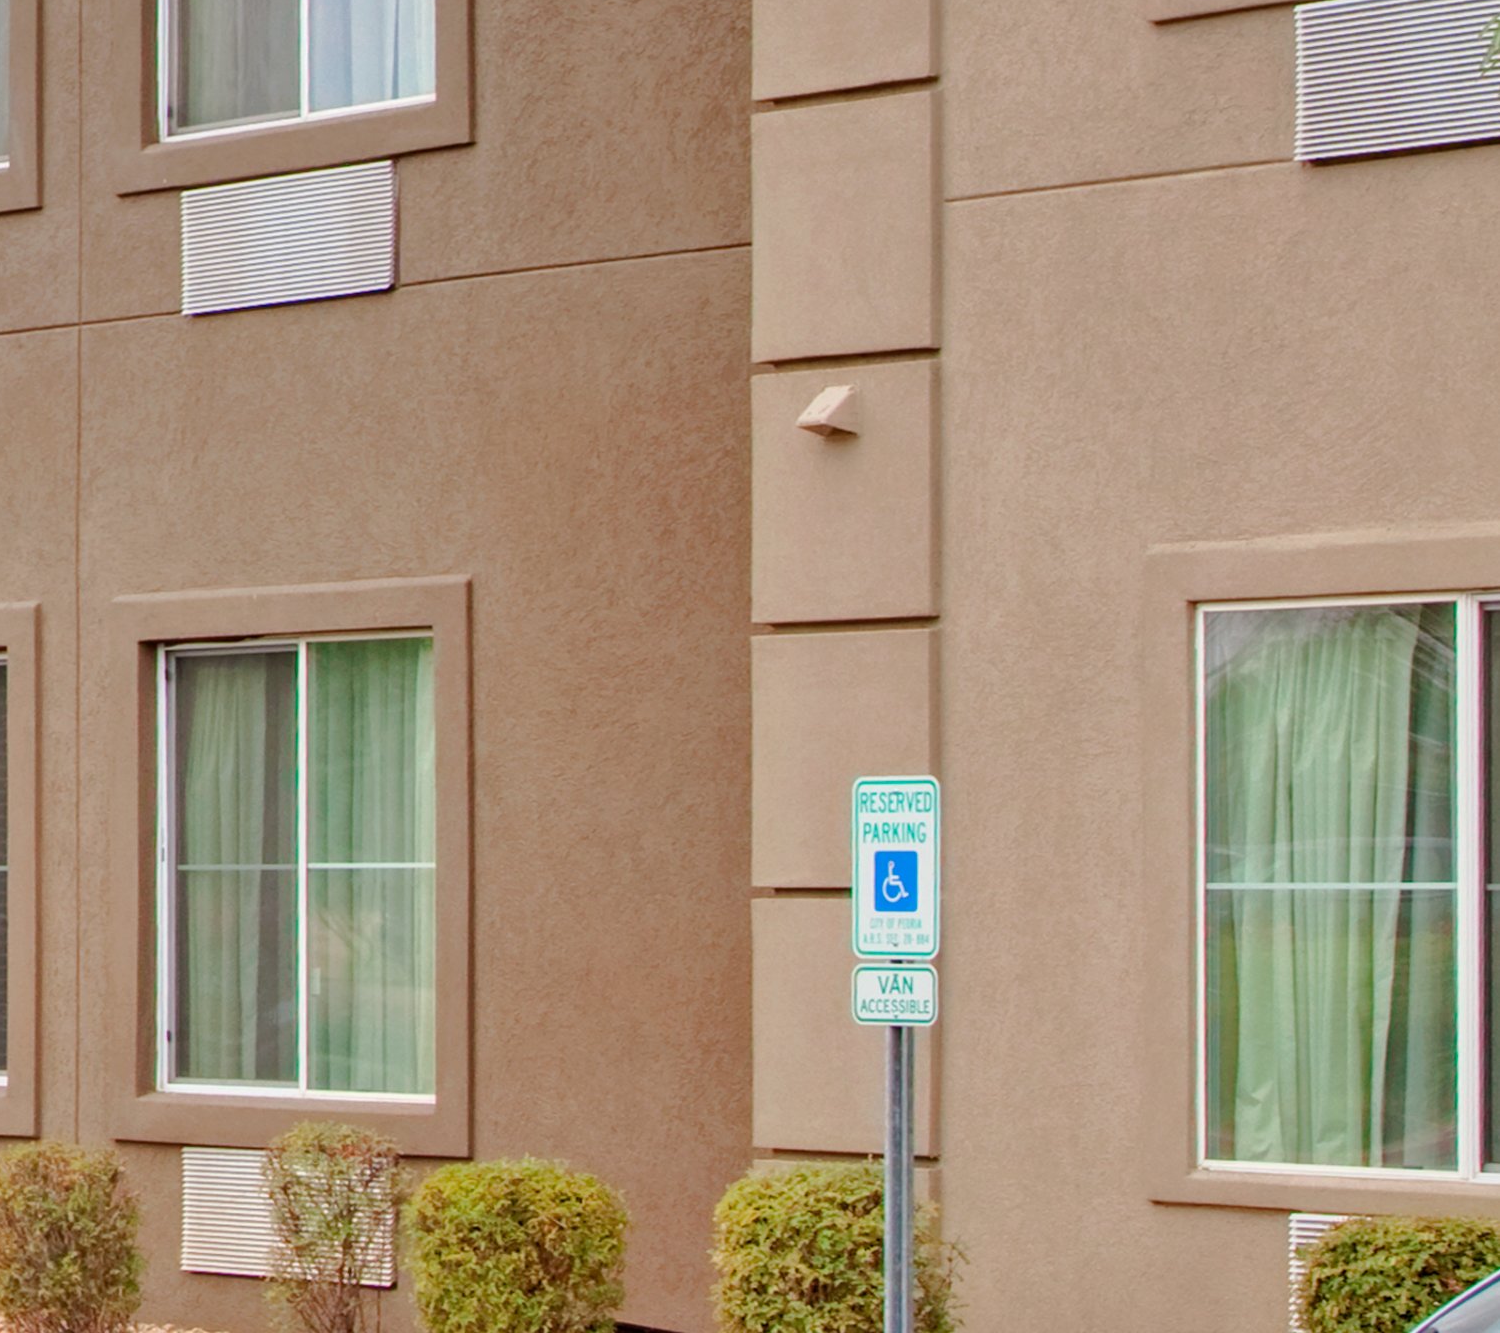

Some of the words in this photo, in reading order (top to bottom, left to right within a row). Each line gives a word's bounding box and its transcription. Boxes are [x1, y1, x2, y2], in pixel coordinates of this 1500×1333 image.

[859, 791, 932, 813] RESERVED
[863, 821, 927, 844] PARKING
[876, 974, 914, 995] VAN
[860, 998, 931, 1014] ACCESSIBLE
